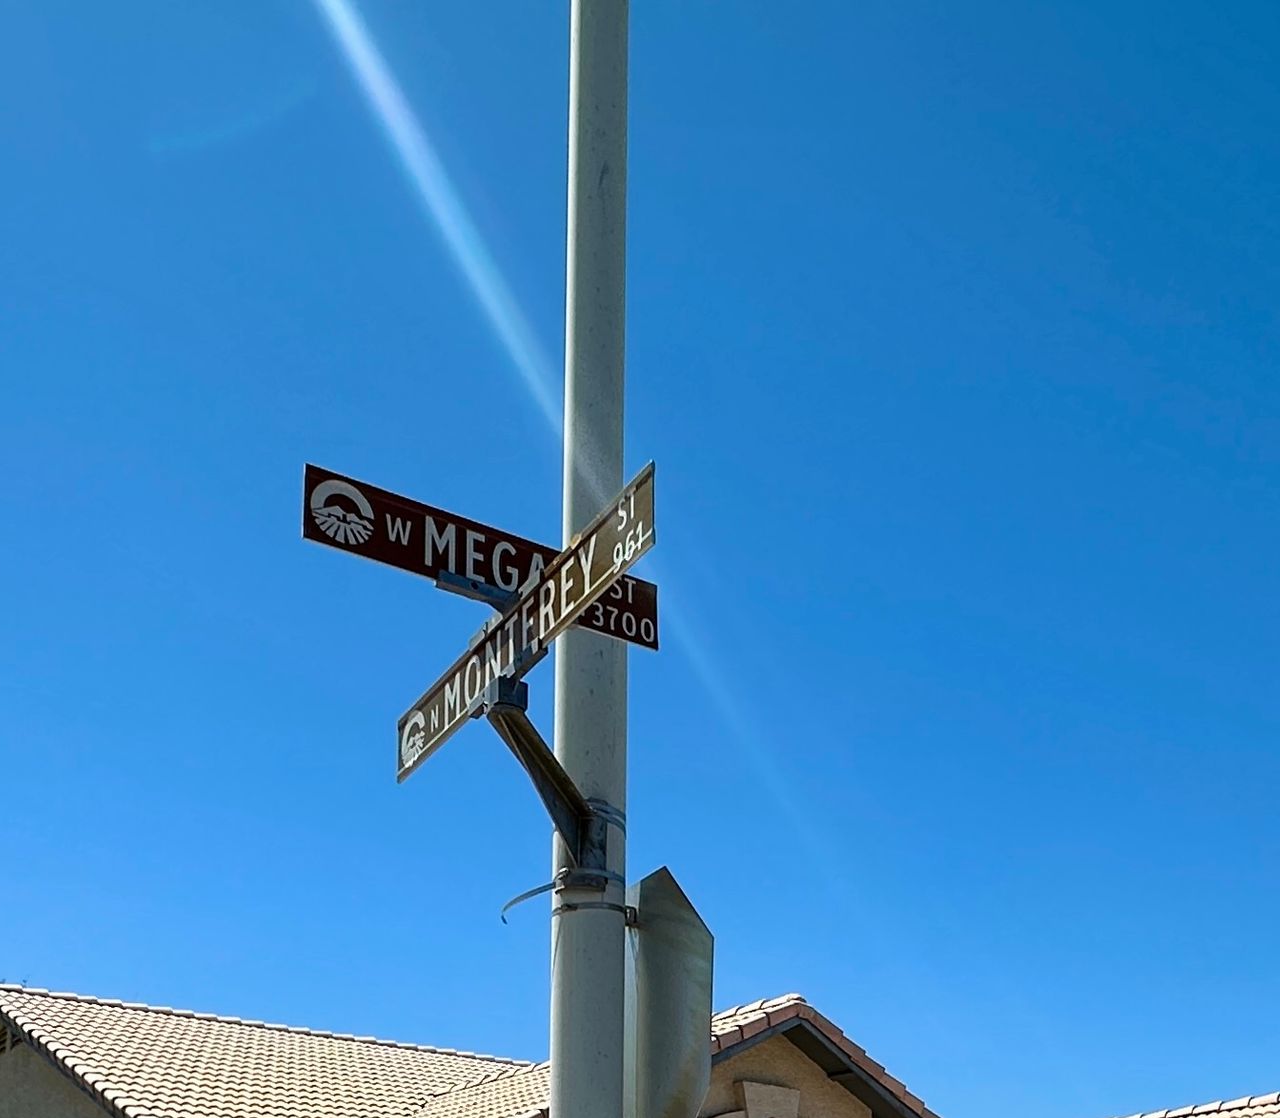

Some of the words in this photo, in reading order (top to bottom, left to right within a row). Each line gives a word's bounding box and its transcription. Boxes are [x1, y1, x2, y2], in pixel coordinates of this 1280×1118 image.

[385, 513, 411, 546] W
[613, 521, 643, 574] 961
[430, 704, 439, 733] N
[444, 533, 597, 729] MONTEREY
[617, 489, 636, 531] ST
[592, 602, 655, 643] 3700
